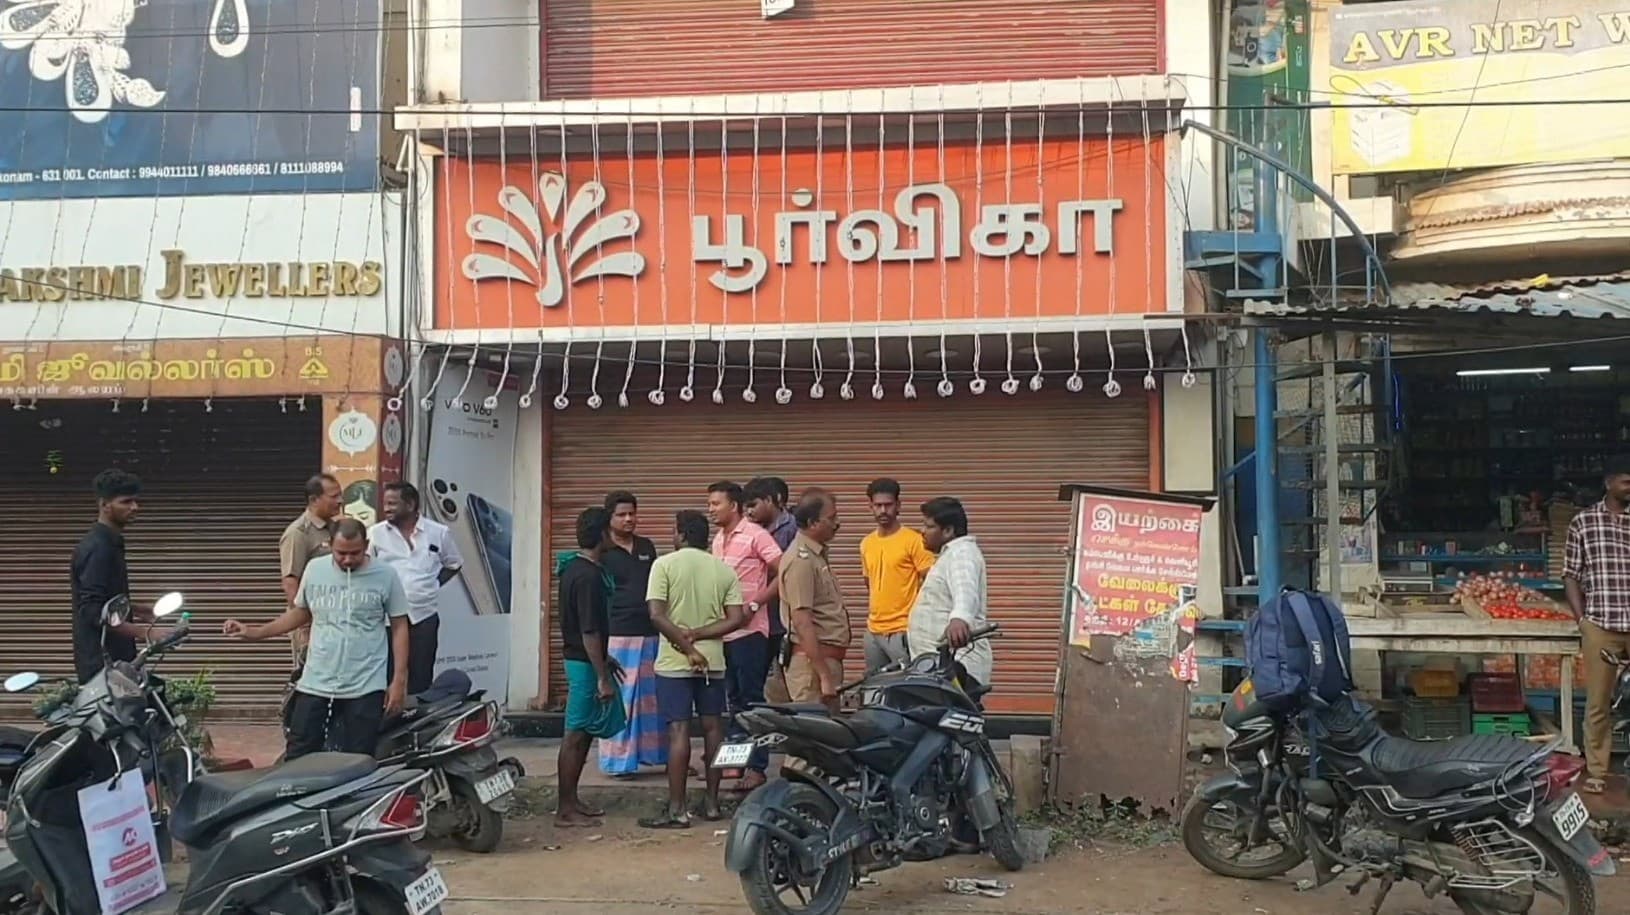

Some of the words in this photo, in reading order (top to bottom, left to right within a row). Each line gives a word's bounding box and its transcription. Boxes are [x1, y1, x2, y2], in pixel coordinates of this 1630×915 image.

[1342, 27, 1456, 63] AVR
[1470, 16, 1581, 54] NET
[88, 168, 130, 180] Contact
[692, 184, 1124, 293] பூர்விகா
[1090, 503, 1199, 534] இயற்கை
[1561, 802, 1586, 837] 9915
